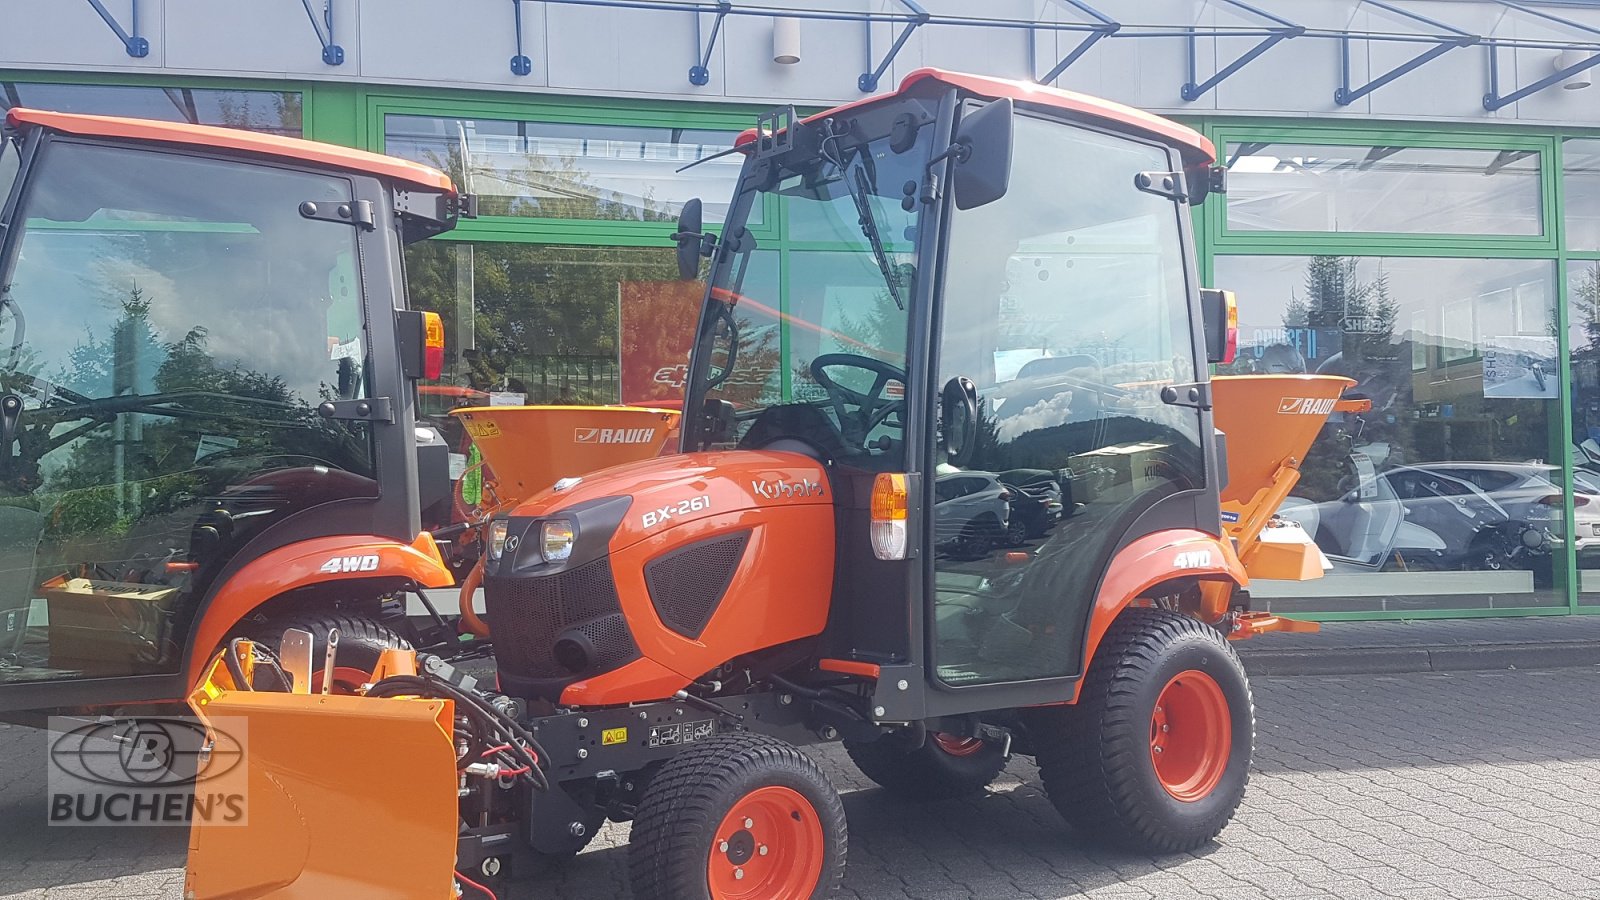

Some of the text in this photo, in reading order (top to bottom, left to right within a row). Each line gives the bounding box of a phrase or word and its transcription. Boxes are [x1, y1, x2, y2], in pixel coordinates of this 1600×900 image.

[600, 428, 655, 444] RAUCH
[752, 478, 824, 499] Kubota
[642, 495, 711, 529] BX-261
[320, 555, 380, 573] 4WD
[1173, 550, 1211, 569] 4WD
